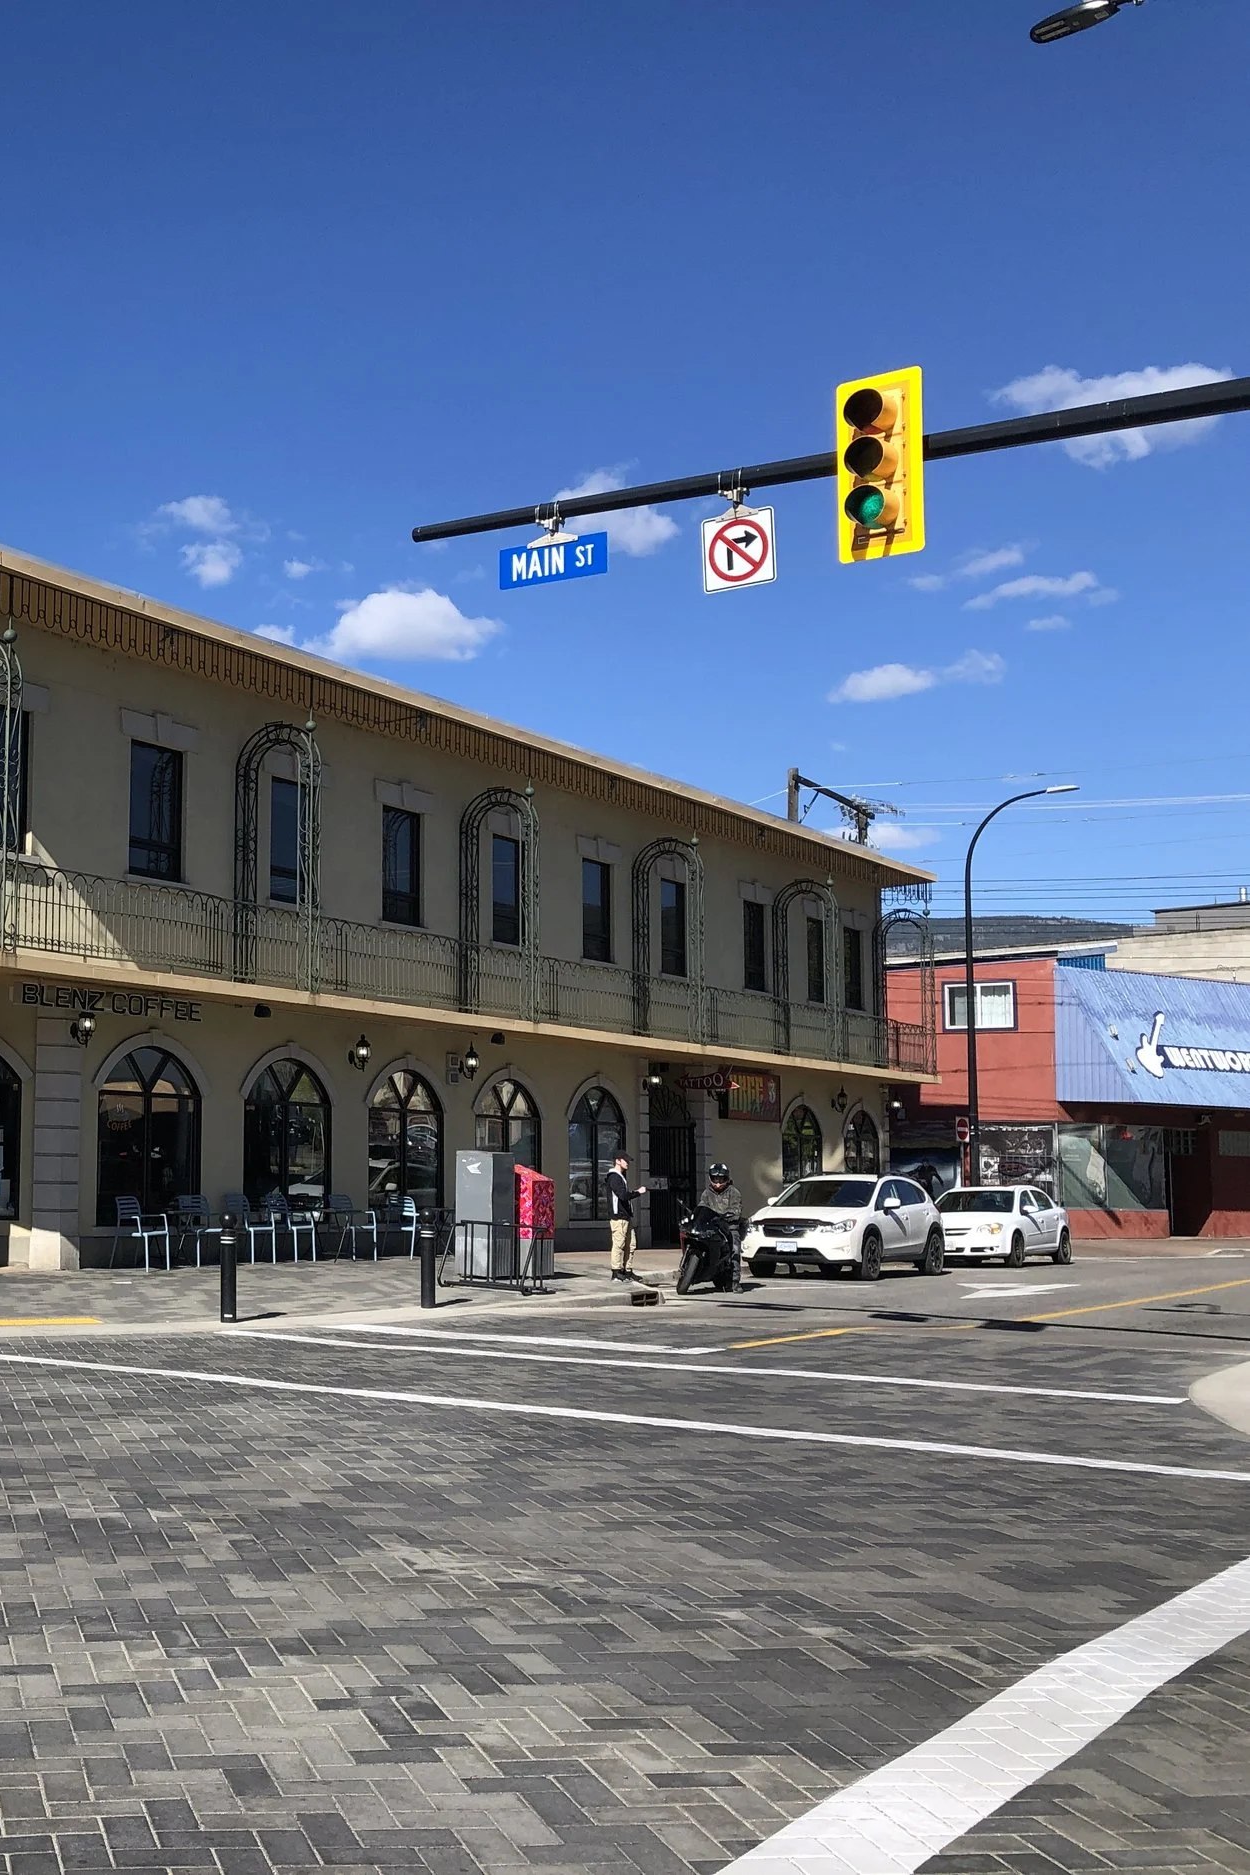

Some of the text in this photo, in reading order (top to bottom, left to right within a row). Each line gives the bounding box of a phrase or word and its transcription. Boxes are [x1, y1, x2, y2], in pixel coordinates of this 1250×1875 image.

[512, 543, 594, 582] MAIN ST
[22, 983, 202, 1022] BLENZ COFFEE
[679, 1072, 724, 1088] TATTOO
